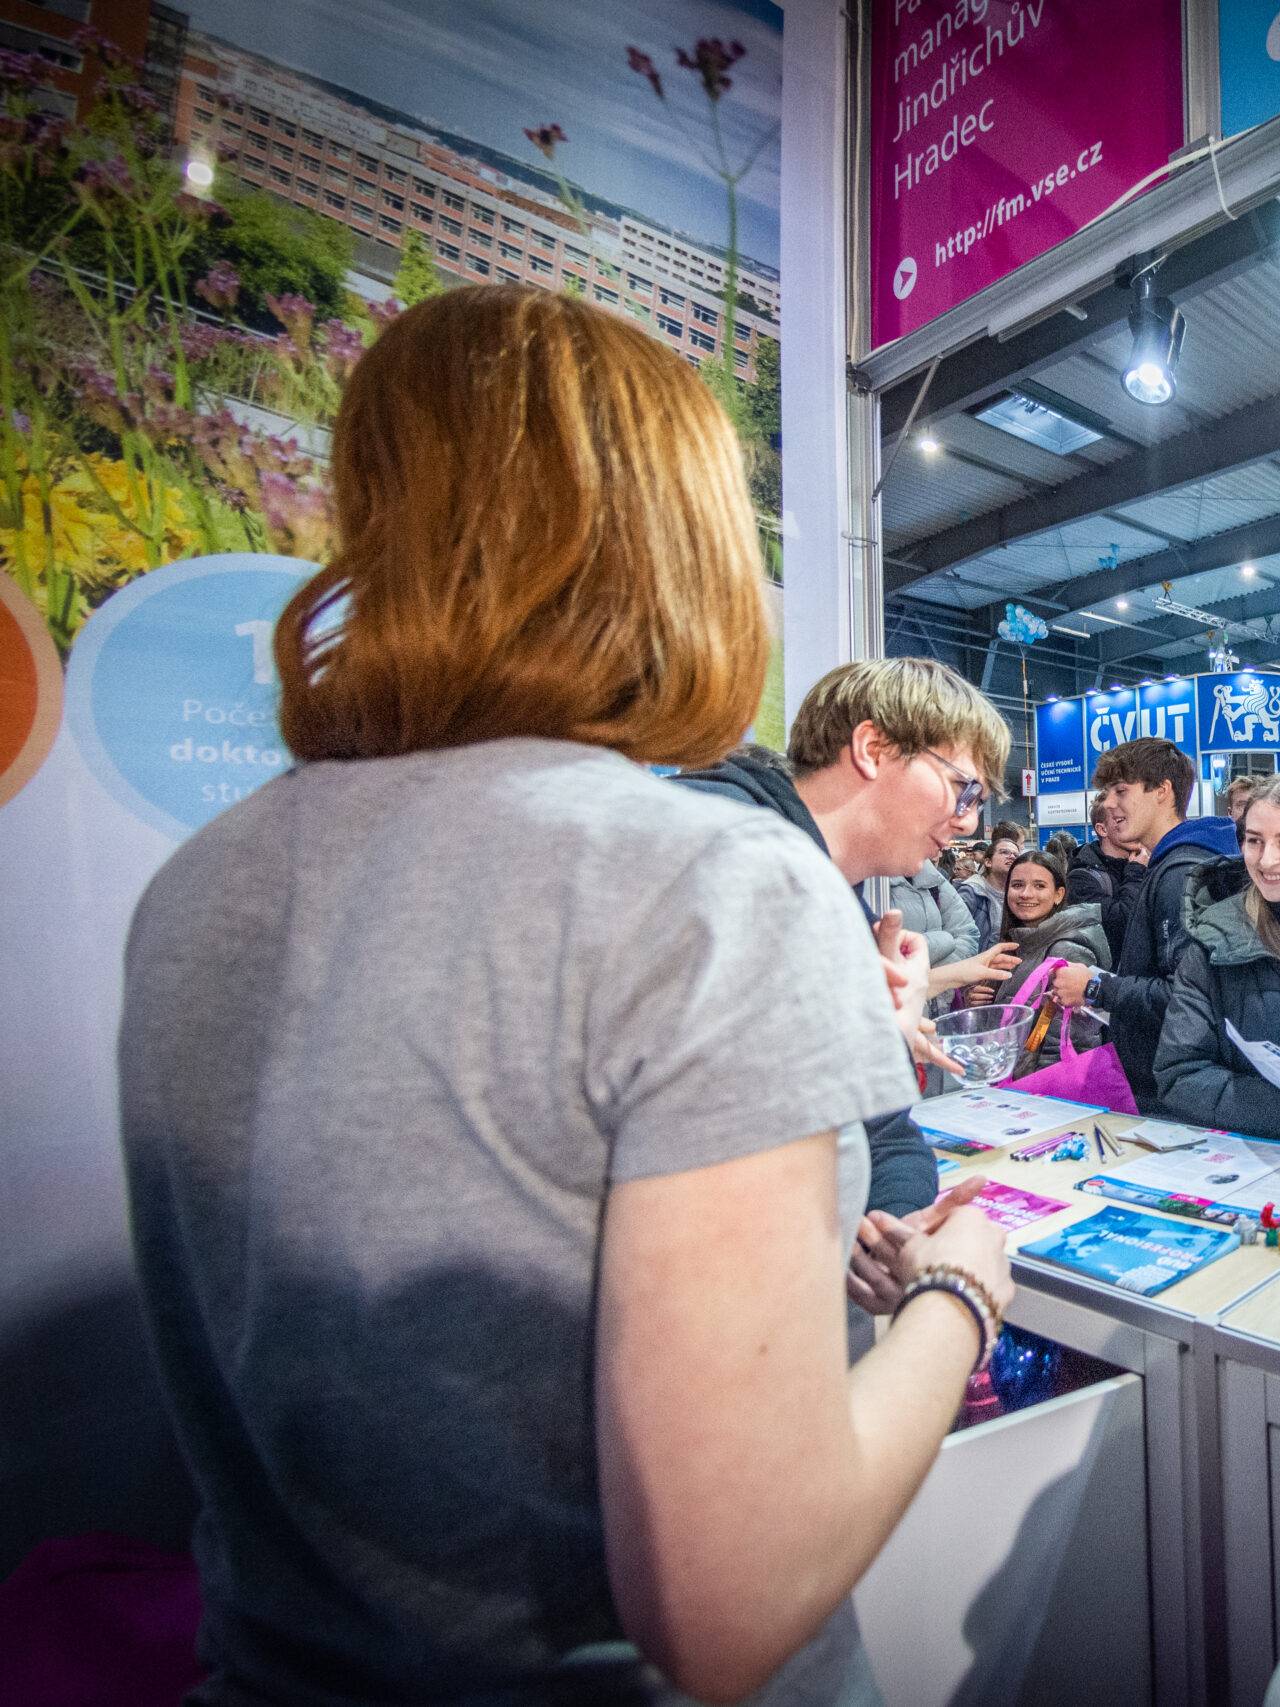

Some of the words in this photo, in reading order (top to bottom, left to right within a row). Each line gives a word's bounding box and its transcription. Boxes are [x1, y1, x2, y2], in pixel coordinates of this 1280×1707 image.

[893, 0, 1044, 143] Jindřichův
[894, 99, 994, 200] Hradec
[935, 141, 1103, 267] http://fm.vse.cz
[182, 699, 267, 726] Poče
[1090, 703, 1190, 752] ČVUT
